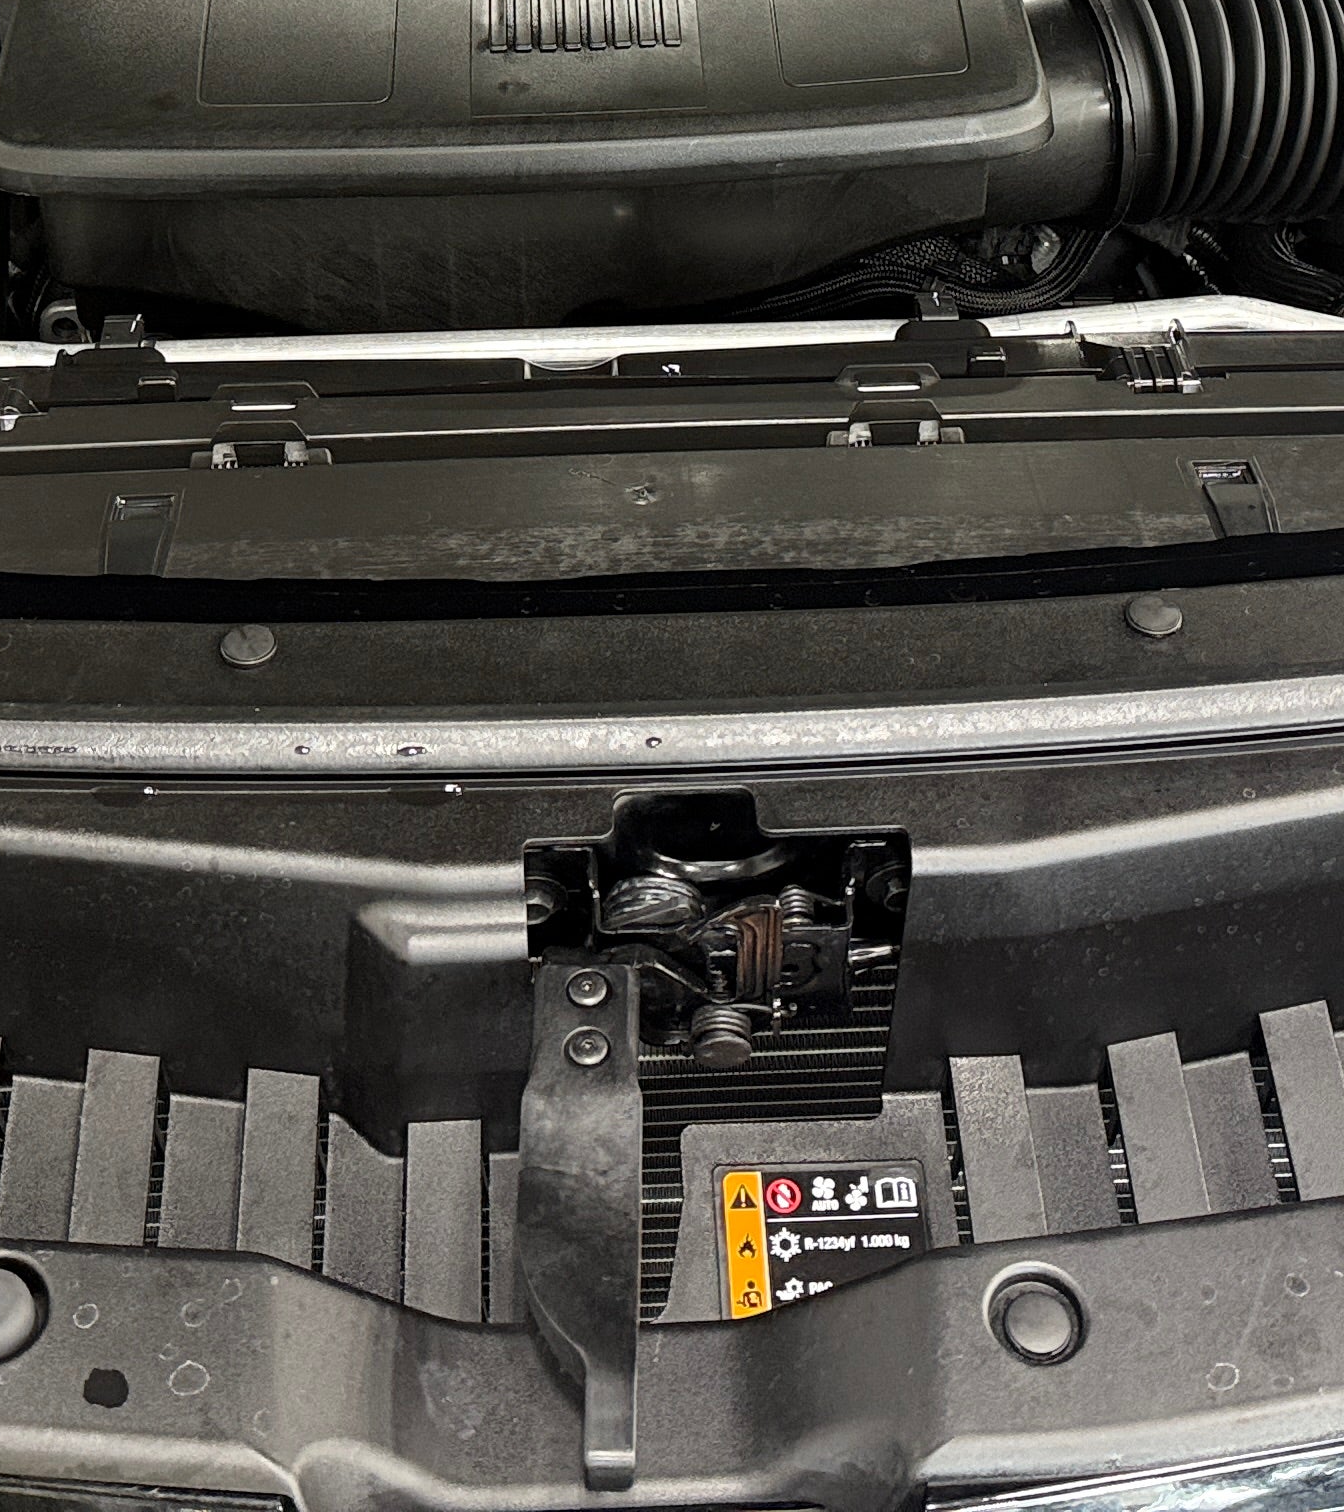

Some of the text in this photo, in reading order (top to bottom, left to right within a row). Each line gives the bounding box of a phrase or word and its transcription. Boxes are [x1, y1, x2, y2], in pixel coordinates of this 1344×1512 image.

[811, 1199, 840, 1212] AUTO
[803, 1235, 856, 1252] R-1234yf
[894, 1233, 910, 1249] kg
